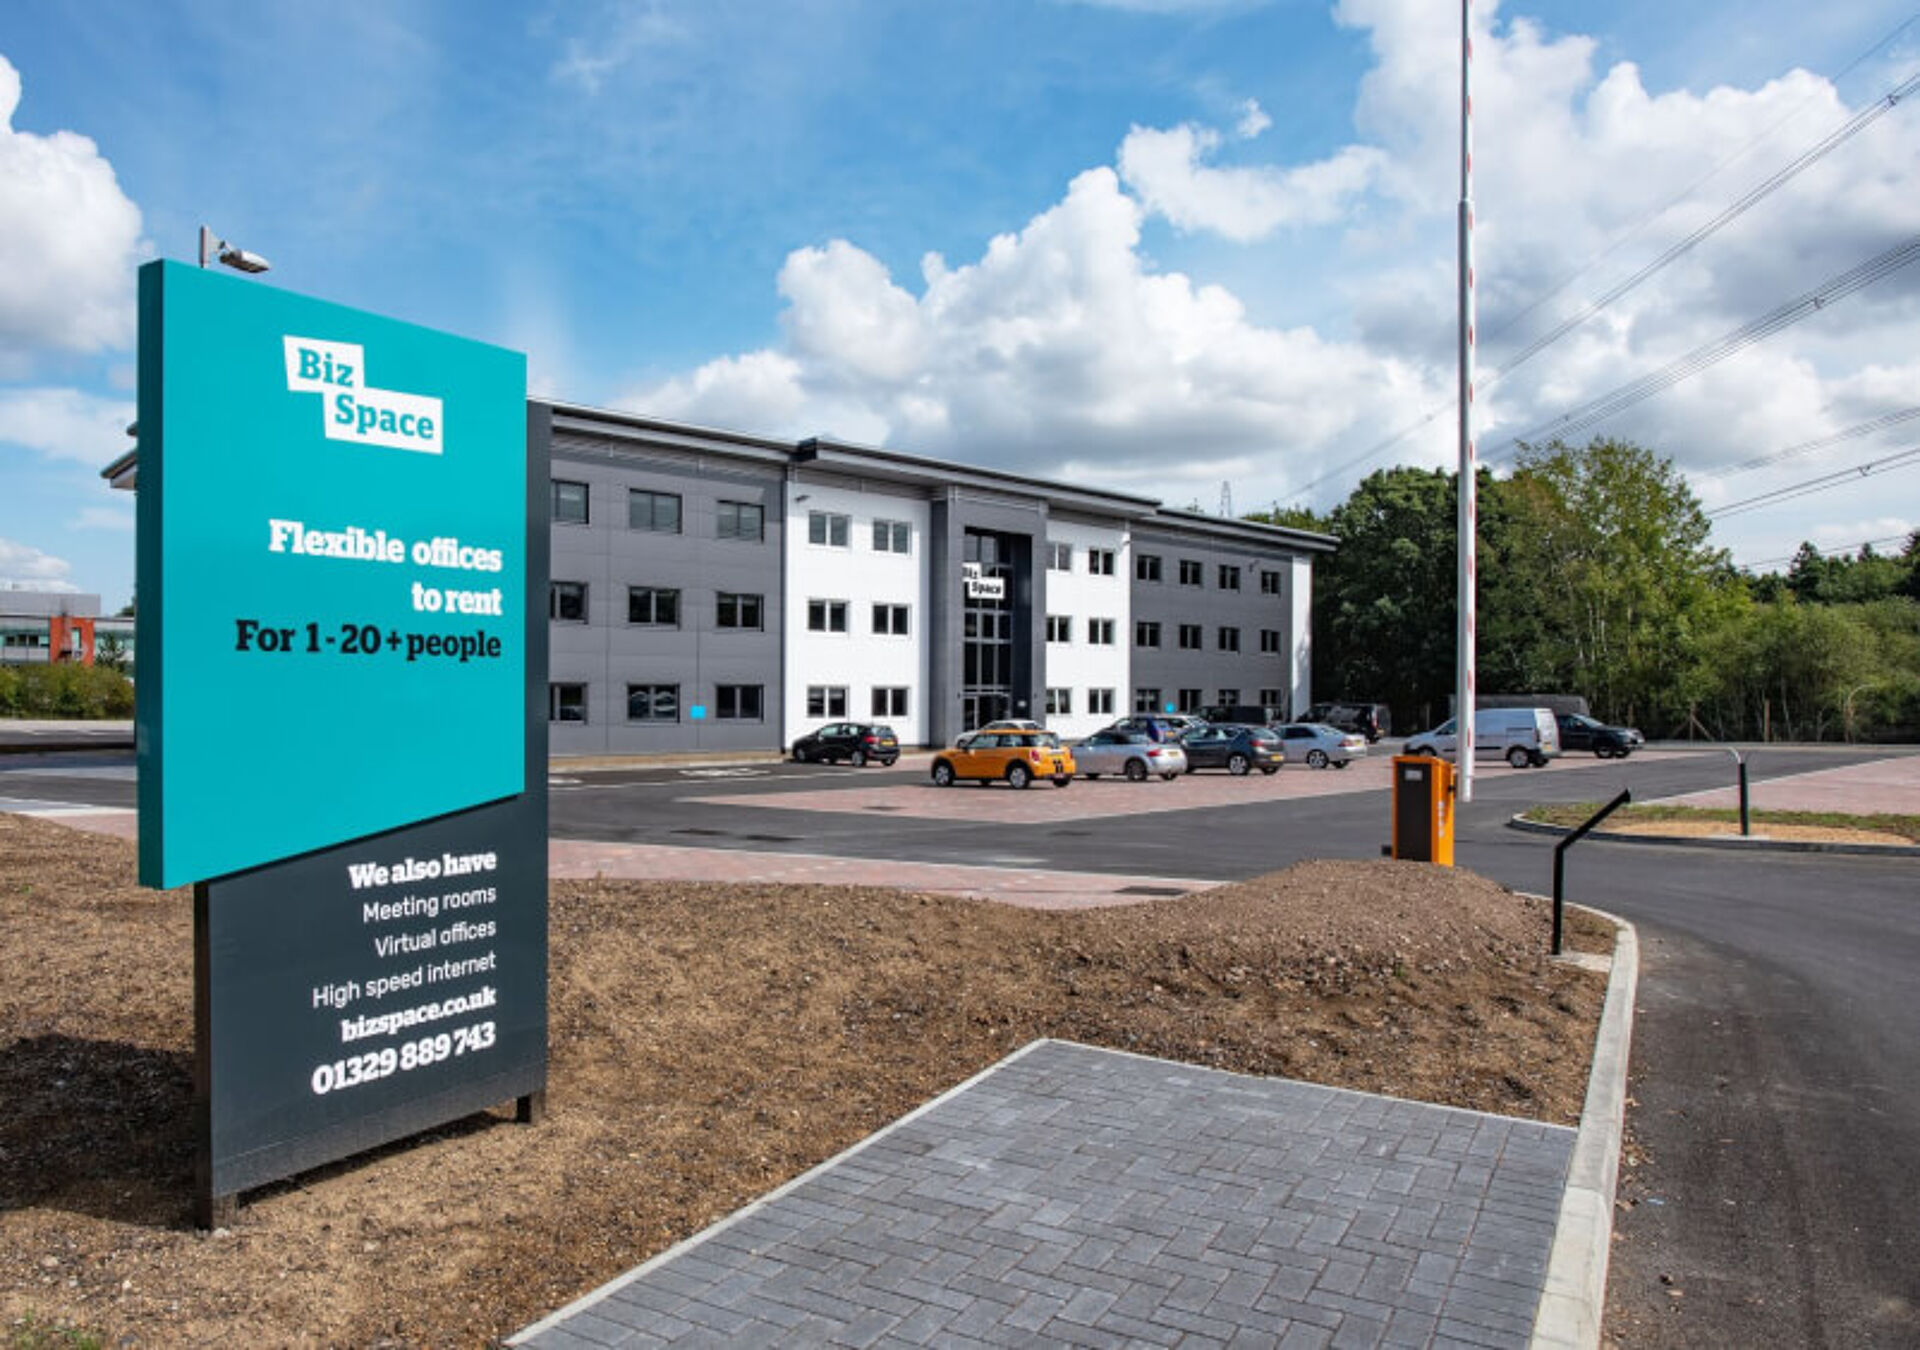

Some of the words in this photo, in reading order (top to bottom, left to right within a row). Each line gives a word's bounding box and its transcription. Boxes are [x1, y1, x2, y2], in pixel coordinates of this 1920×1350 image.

[297, 348, 354, 388] Biz
[335, 395, 434, 440] Space
[268, 518, 405, 562] Flexible
[412, 538, 503, 572] offices
[411, 582, 440, 612] to
[445, 587, 503, 616] rent
[235, 619, 295, 652] For
[348, 863, 389, 889] We
[390, 858, 441, 883] also
[443, 850, 497, 877] have
[362, 893, 439, 923] Meeting
[443, 887, 497, 910] rooms
[374, 929, 436, 958] Virtual
[440, 919, 497, 945] offices
[312, 980, 360, 1009] High
[365, 966, 422, 1000] speed
[427, 951, 497, 982] internet
[341, 986, 497, 1042] bizspace.co.uk
[311, 1048, 399, 1095] 01329
[400, 1034, 451, 1072] 889
[453, 1021, 497, 1058] 743
